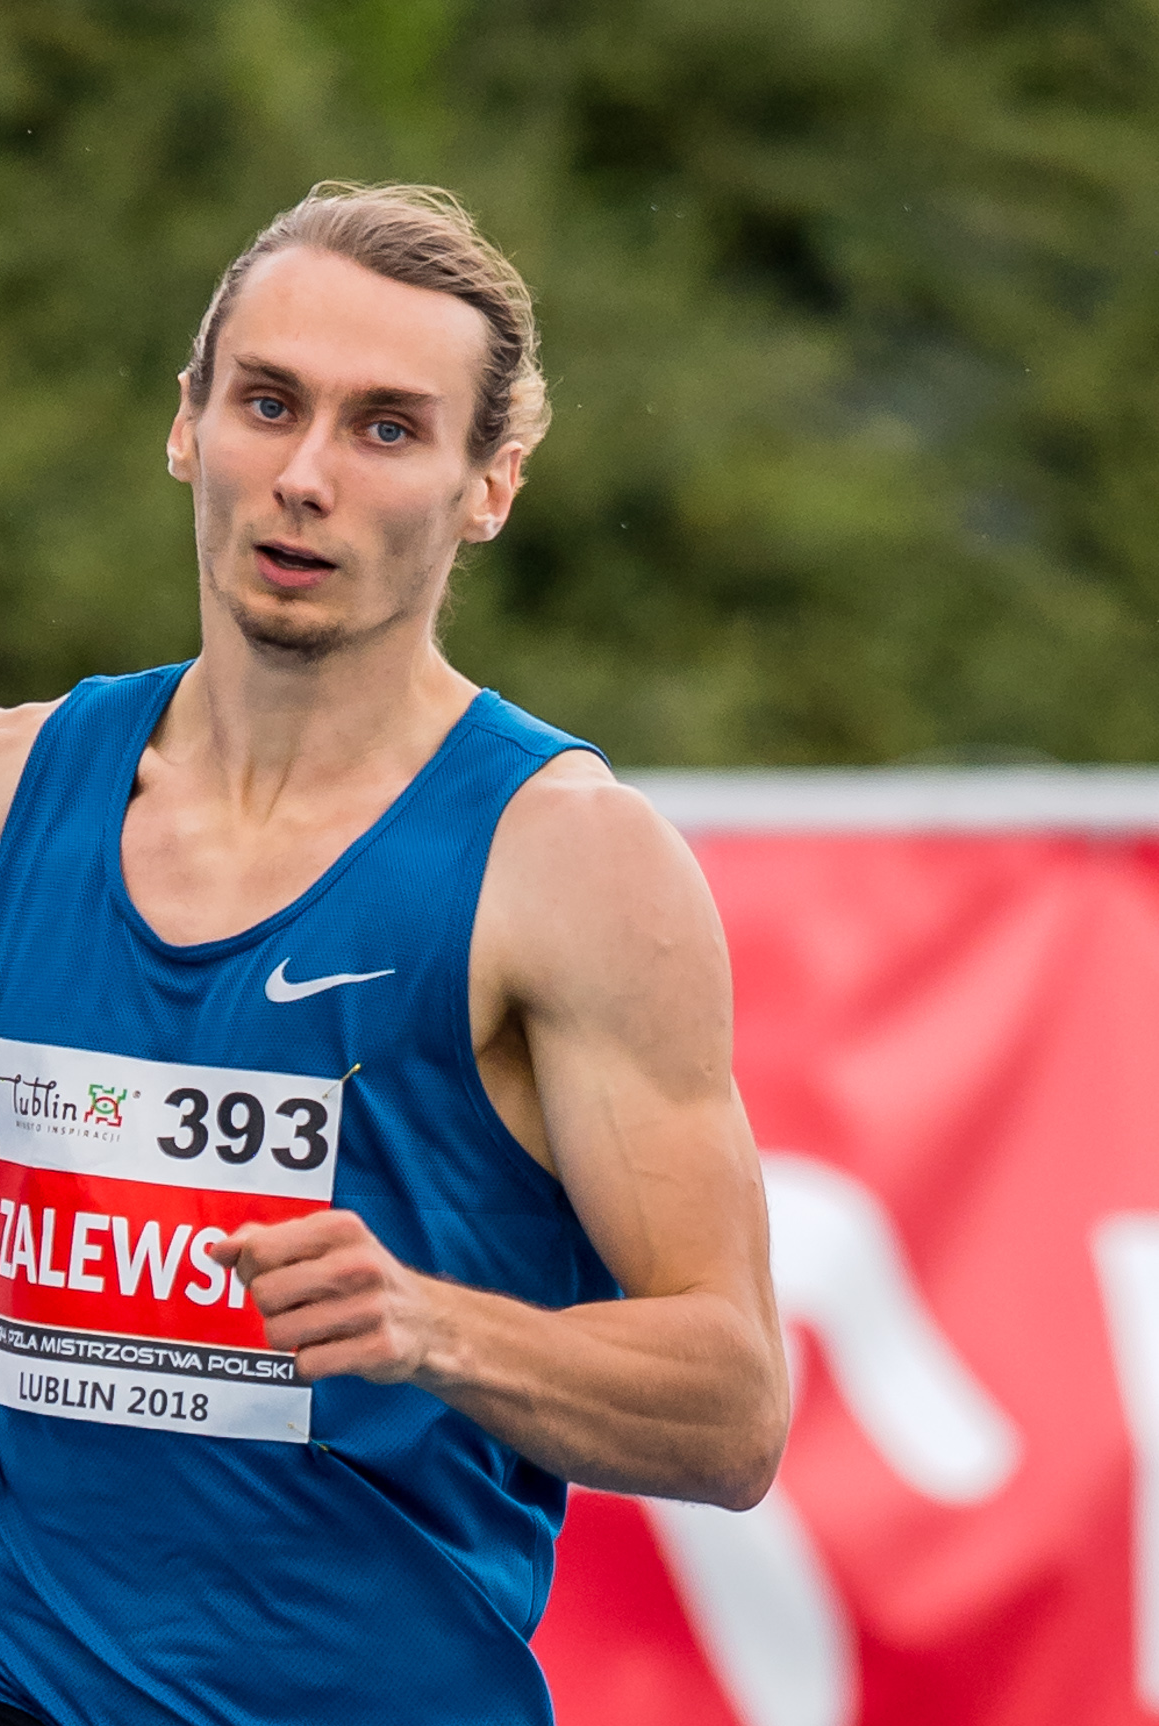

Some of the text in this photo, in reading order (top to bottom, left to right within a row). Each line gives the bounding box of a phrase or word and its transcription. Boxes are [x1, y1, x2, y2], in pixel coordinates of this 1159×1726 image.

[156, 1087, 329, 1171] 393
[40, 1335, 203, 1371] MISTRZOSTWA
[207, 1354, 295, 1380] POLSKI
[18, 1371, 209, 1422] LUBLIN 2018
